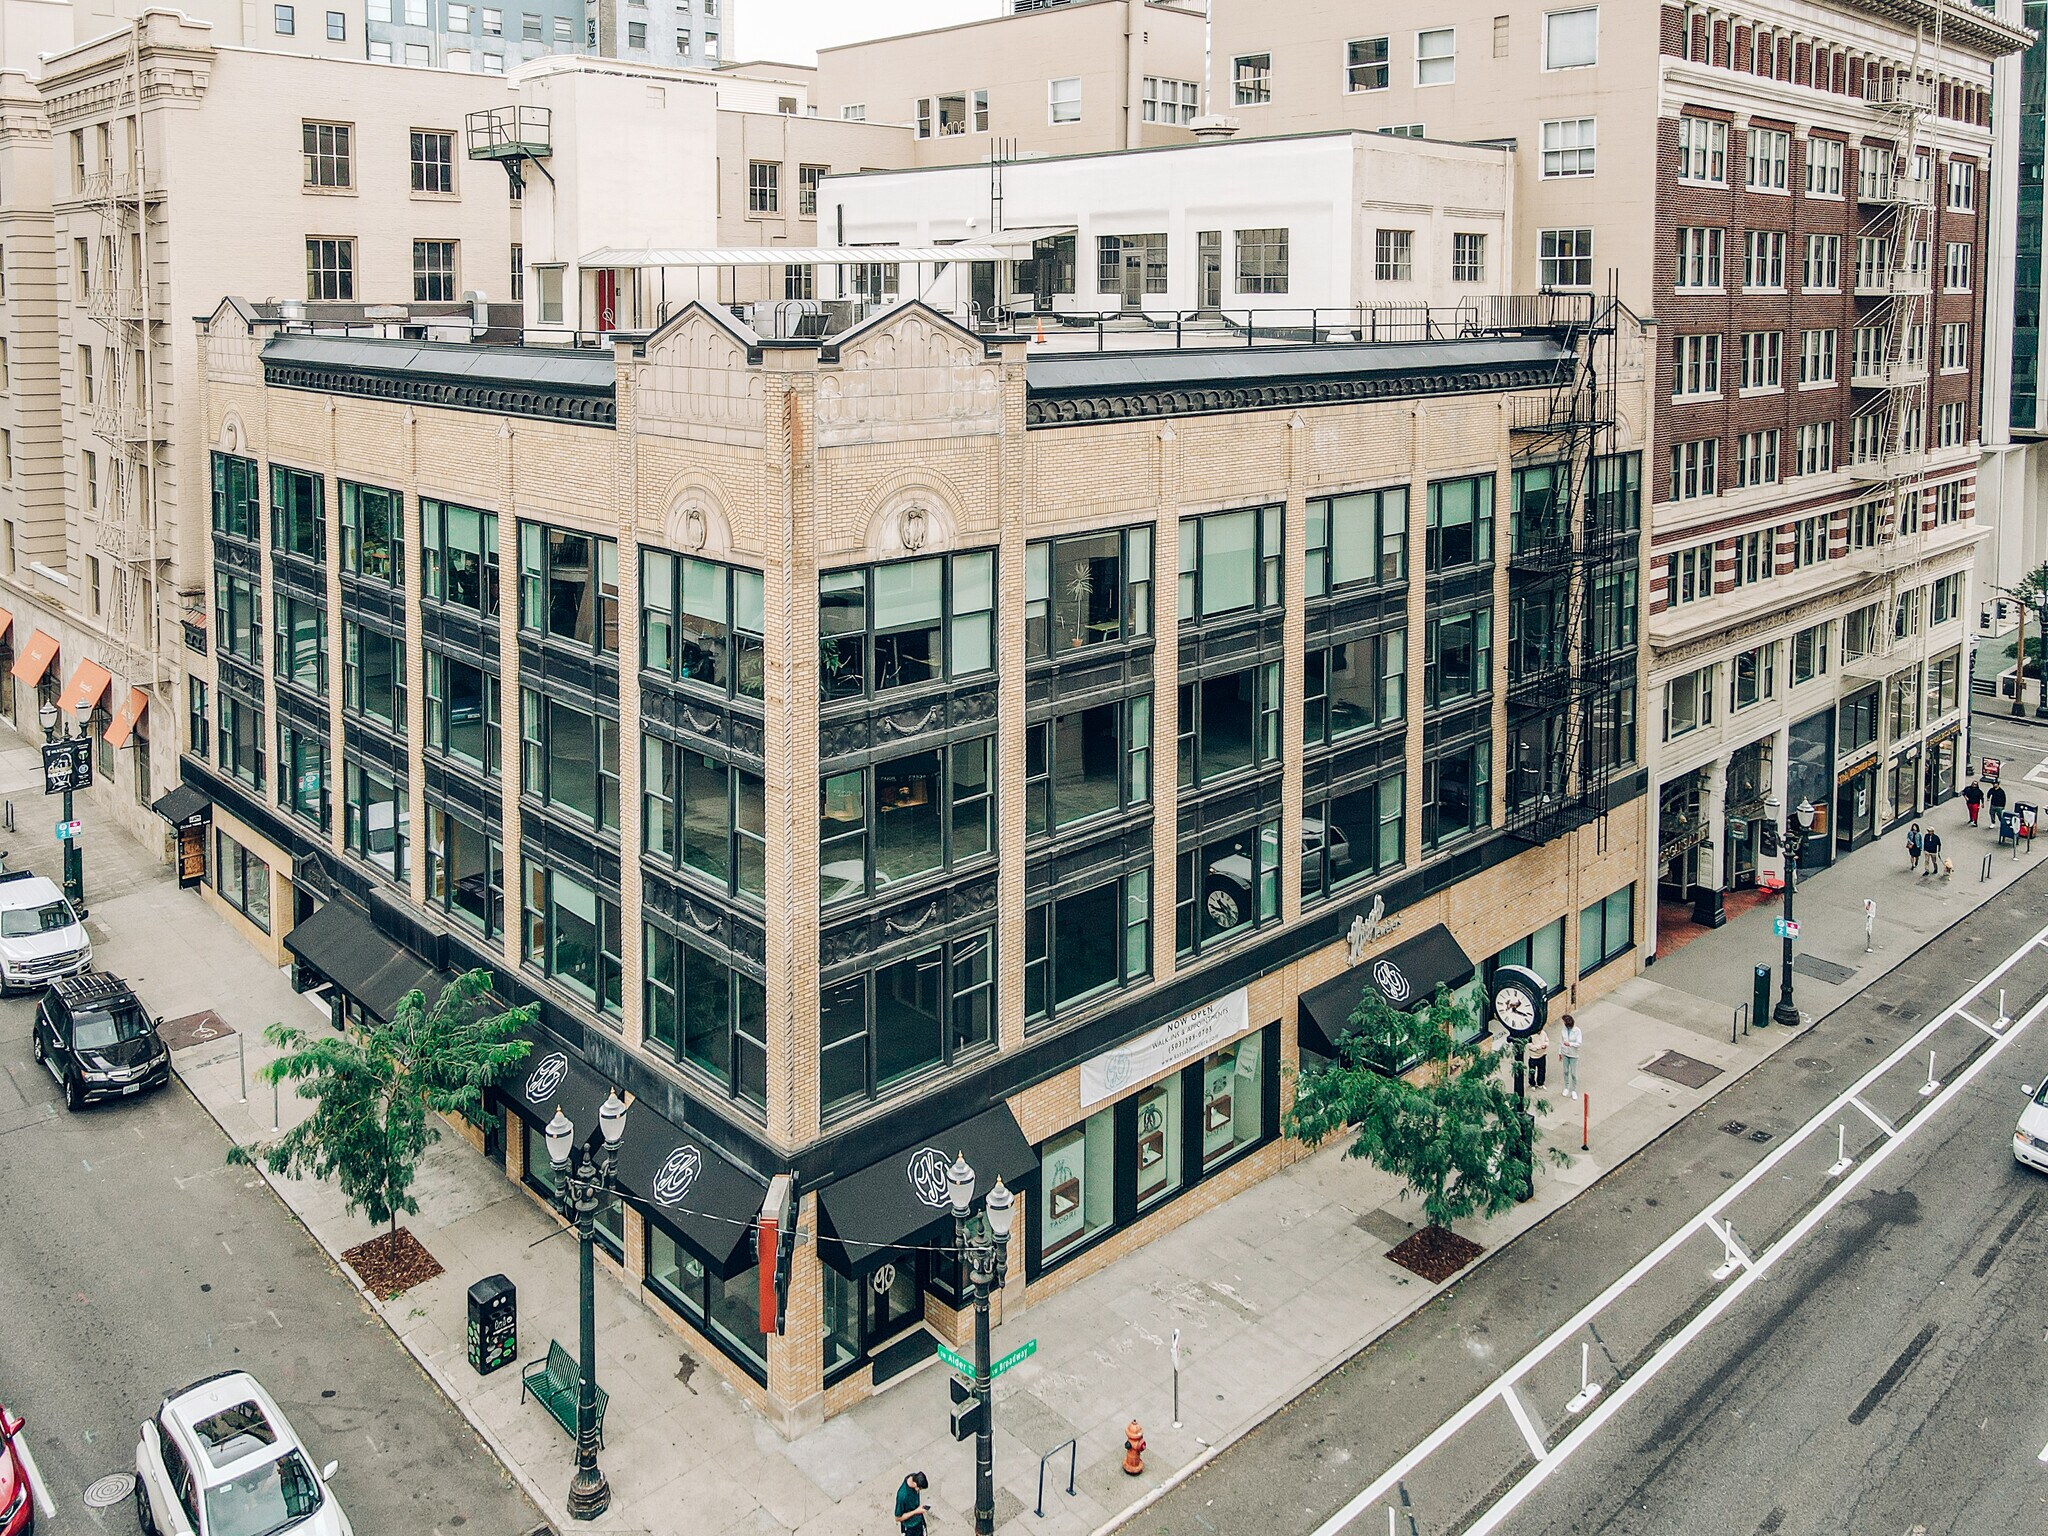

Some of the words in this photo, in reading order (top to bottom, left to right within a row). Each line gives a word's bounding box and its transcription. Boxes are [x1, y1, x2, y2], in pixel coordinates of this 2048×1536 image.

[1167, 1016, 1188, 1033] NOW
[1191, 1005, 1213, 1021] OPEN
[1151, 1030, 1180, 1050] WALK-INS
[1050, 1211, 1076, 1228] TACORI
[948, 1353, 967, 1371] Alder
[999, 1348, 1029, 1371] Broadway
